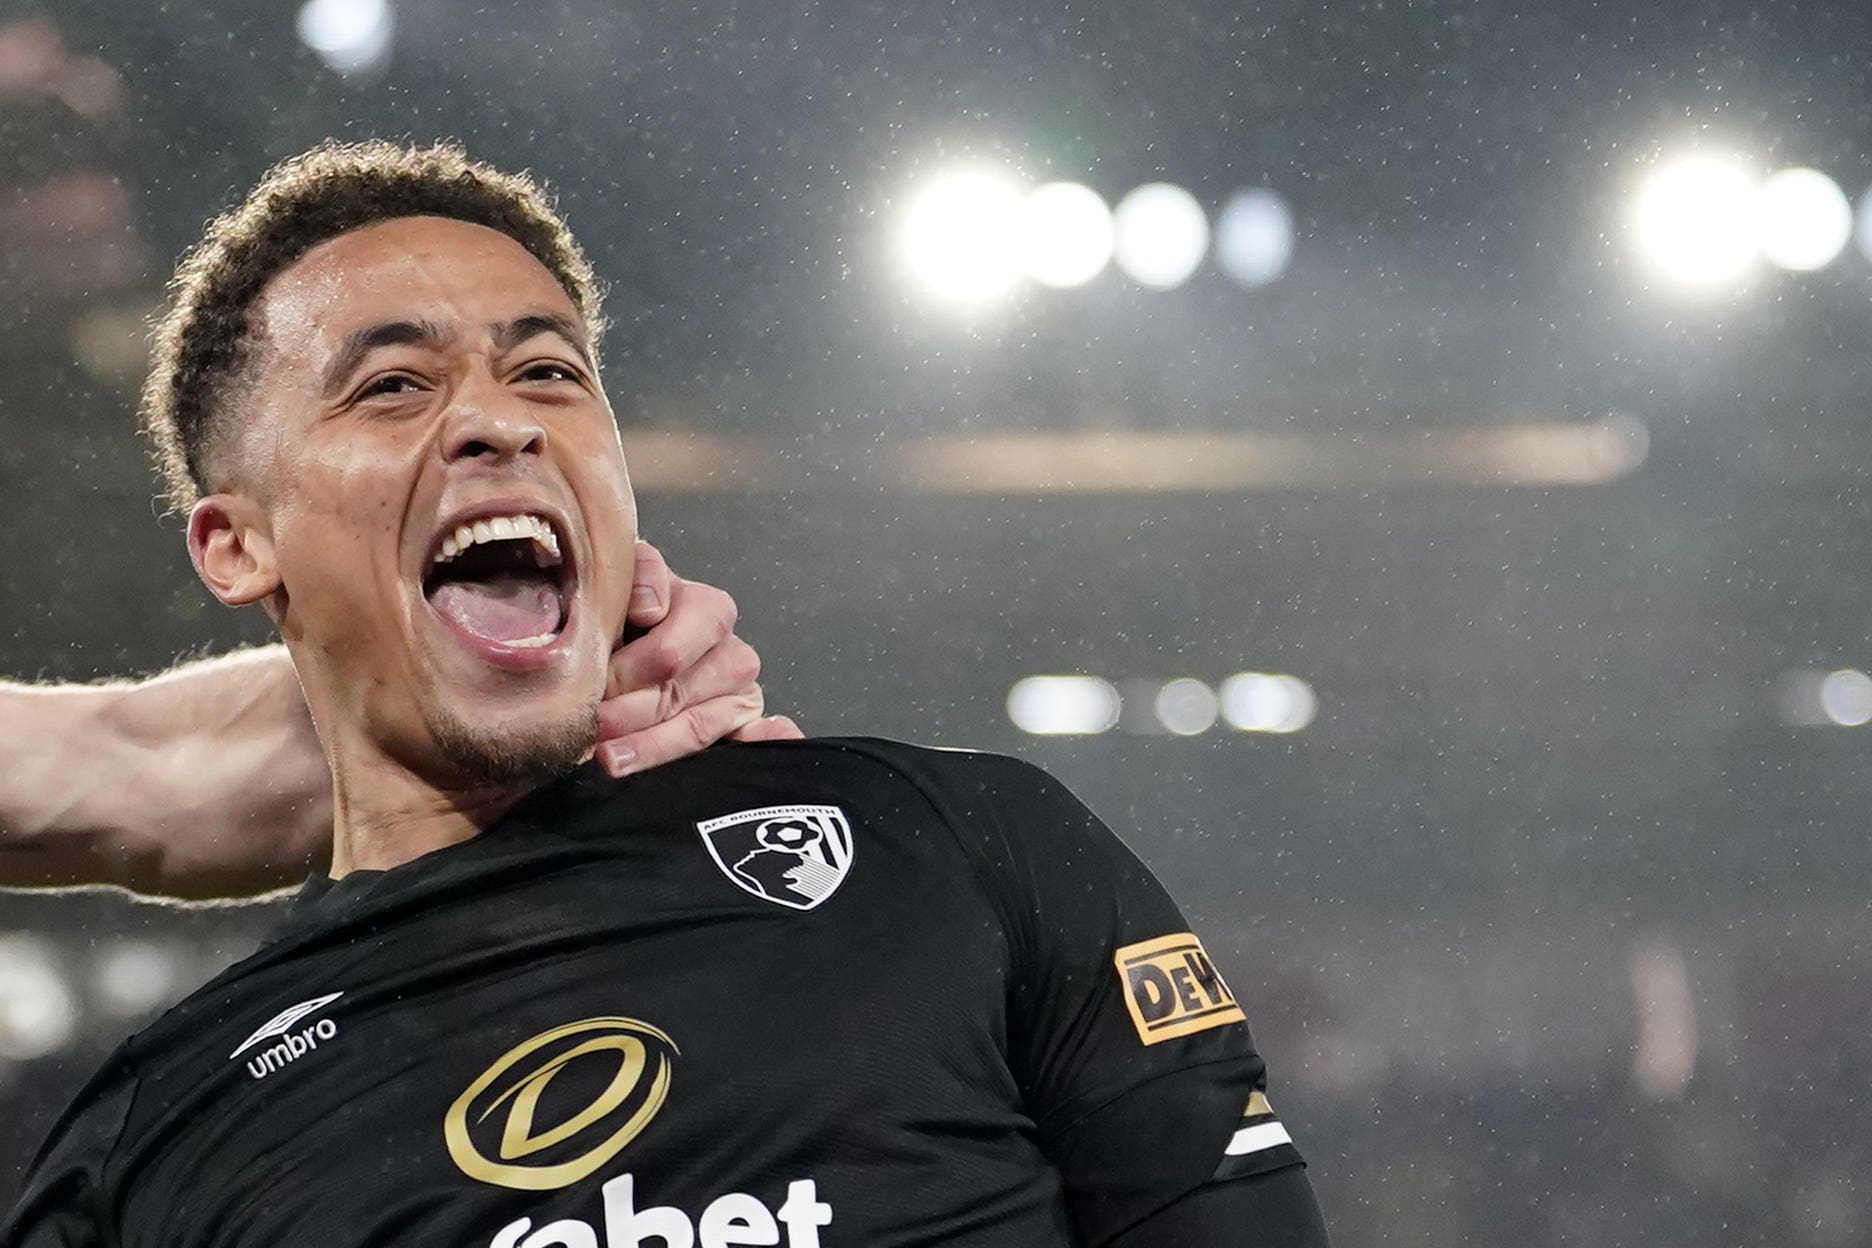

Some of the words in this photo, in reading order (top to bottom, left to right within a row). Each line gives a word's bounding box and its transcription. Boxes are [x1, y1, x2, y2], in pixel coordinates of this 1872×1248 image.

[703, 819, 729, 830] AFC
[730, 807, 836, 822] BOURNEMOUTH
[247, 1018, 337, 1079] umbro
